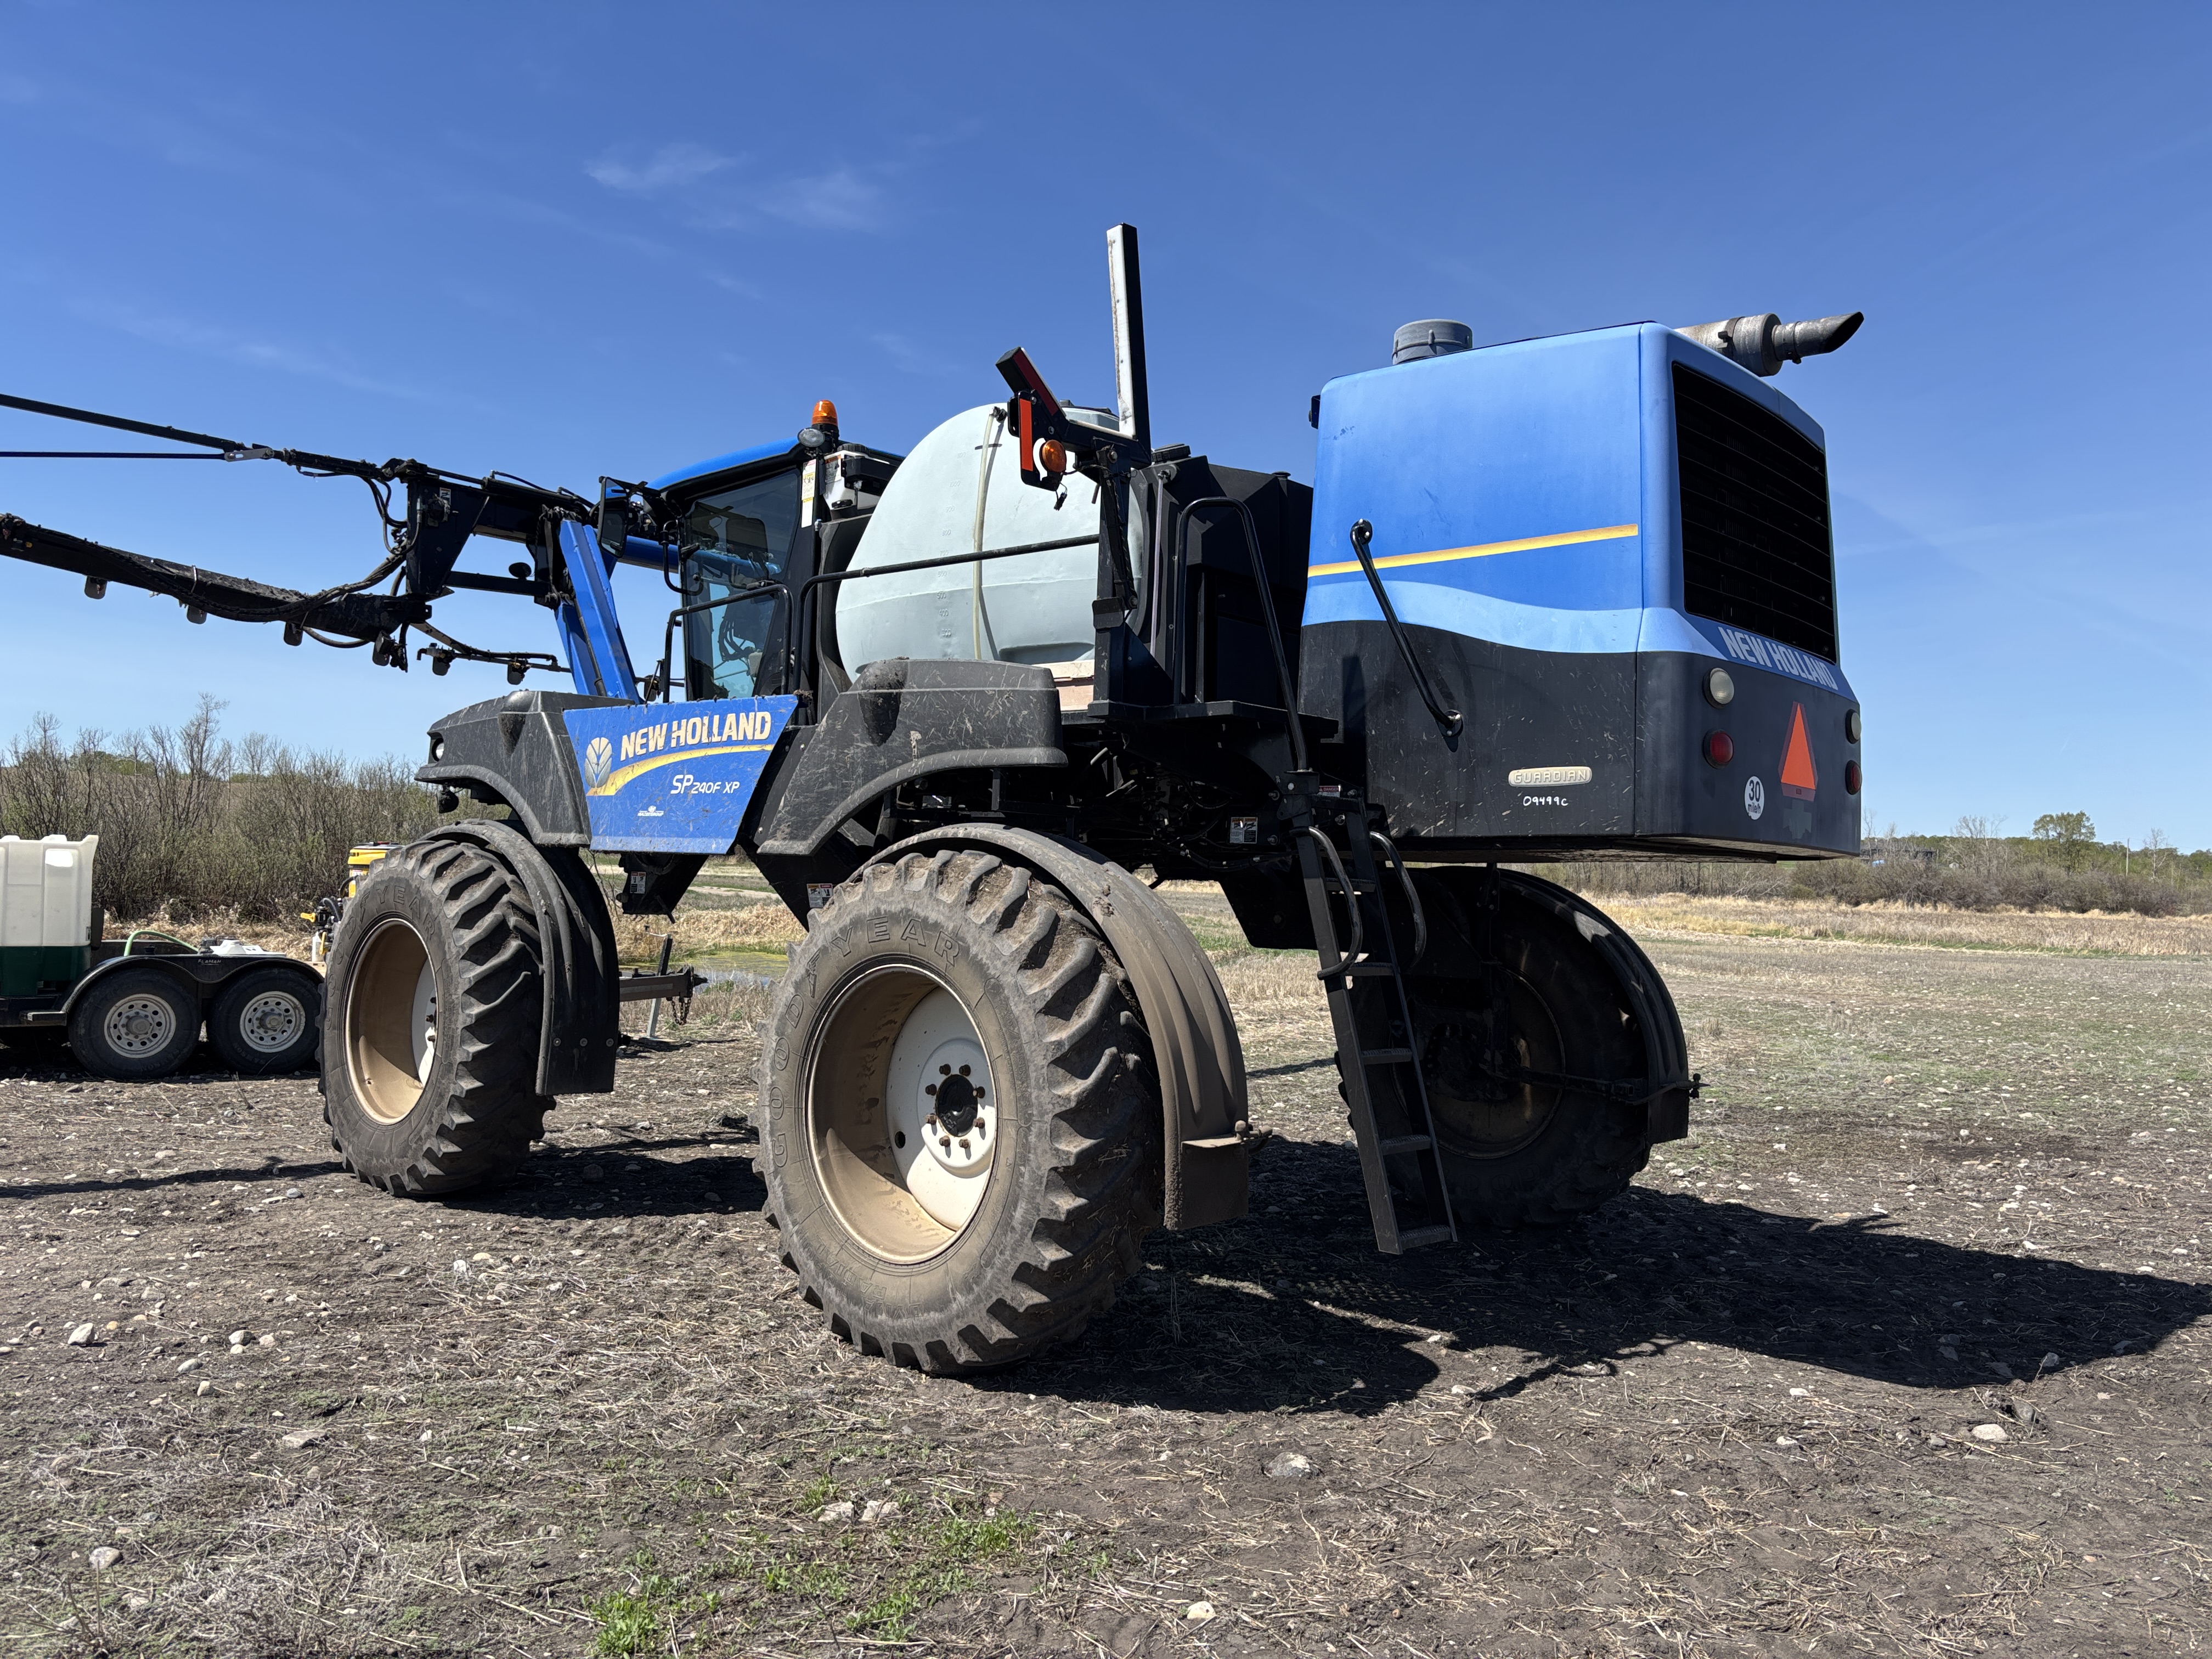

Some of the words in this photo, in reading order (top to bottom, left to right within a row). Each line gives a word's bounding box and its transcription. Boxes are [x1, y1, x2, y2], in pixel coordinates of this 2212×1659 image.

[1718, 626, 1773, 668] NEW
[1765, 641, 1838, 690] HOLLAND
[620, 723, 668, 761] NEW
[670, 711, 771, 748] HOLLAND
[723, 781, 740, 794] XP
[1514, 769, 1587, 784] GUARDIAN
[1748, 779, 1760, 802] 30
[769, 916, 961, 1169] GOODYEAR
